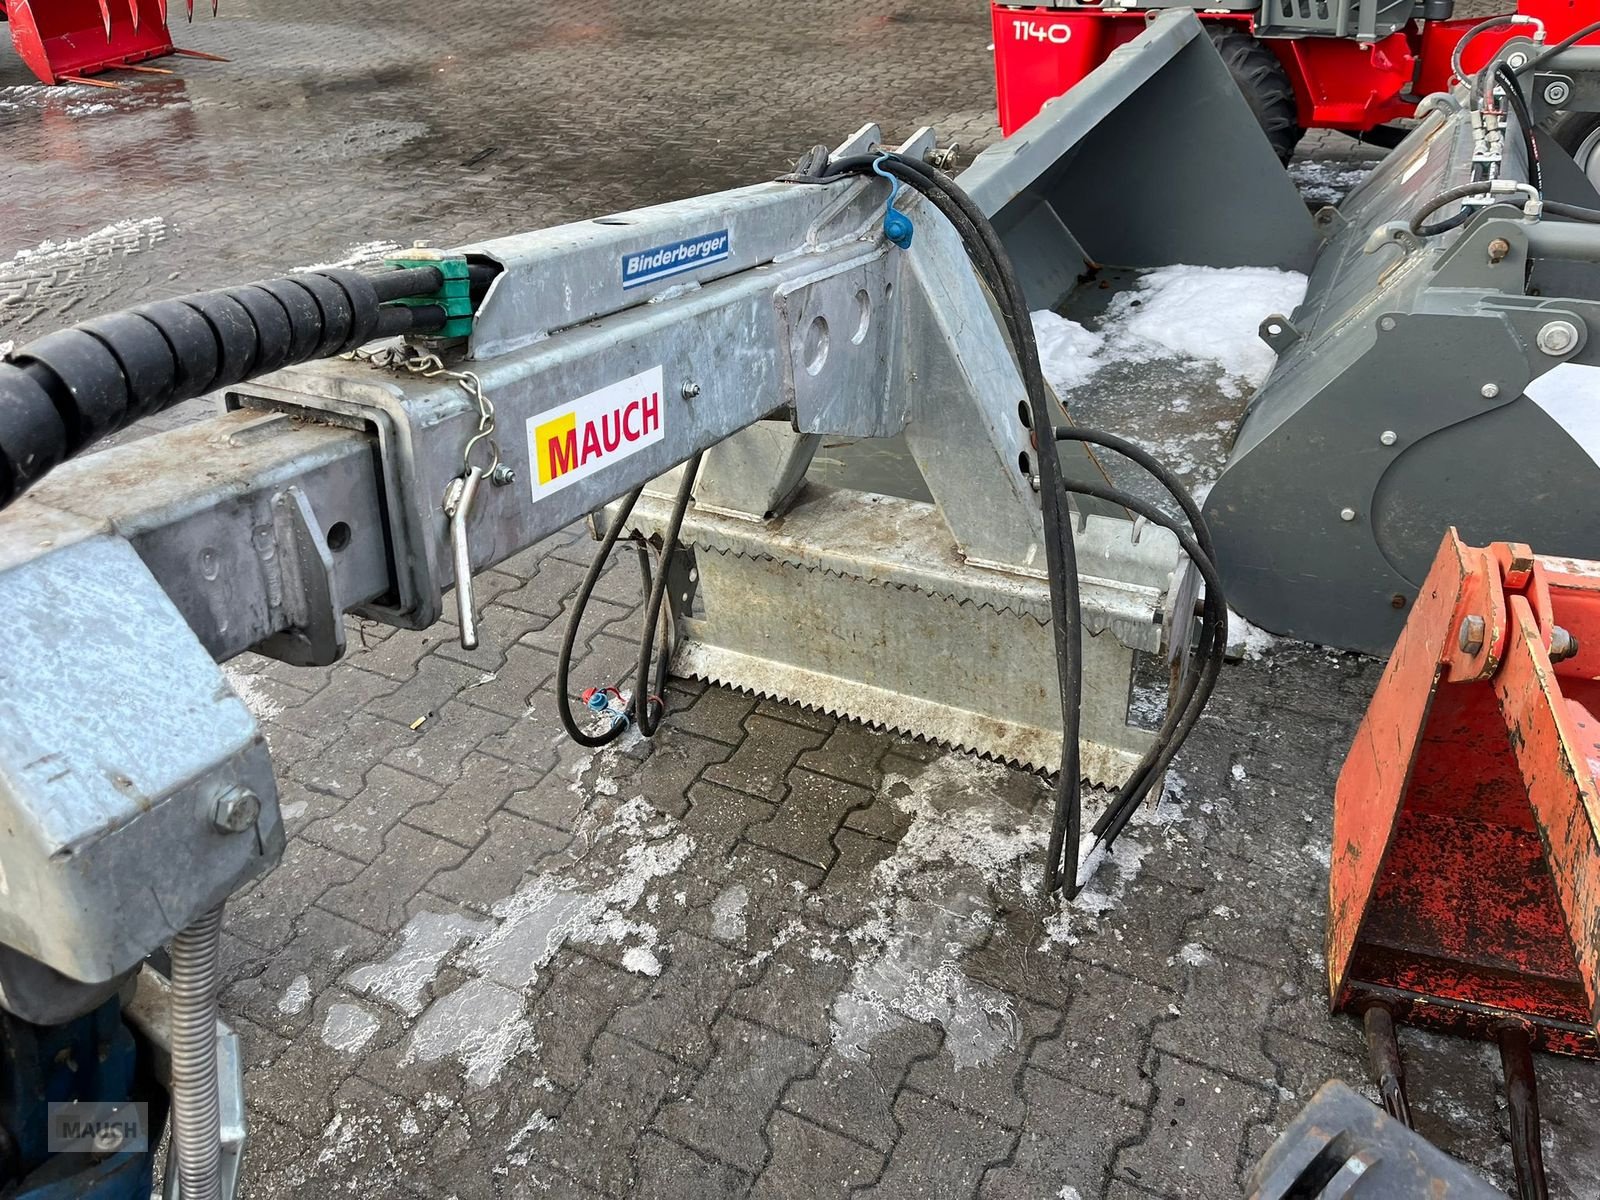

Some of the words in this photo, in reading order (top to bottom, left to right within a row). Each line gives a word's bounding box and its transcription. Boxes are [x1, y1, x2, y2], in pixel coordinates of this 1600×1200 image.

[1012, 20, 1072, 44] 1140
[626, 235, 727, 275] Binderberger
[548, 391, 659, 481] MAUCH
